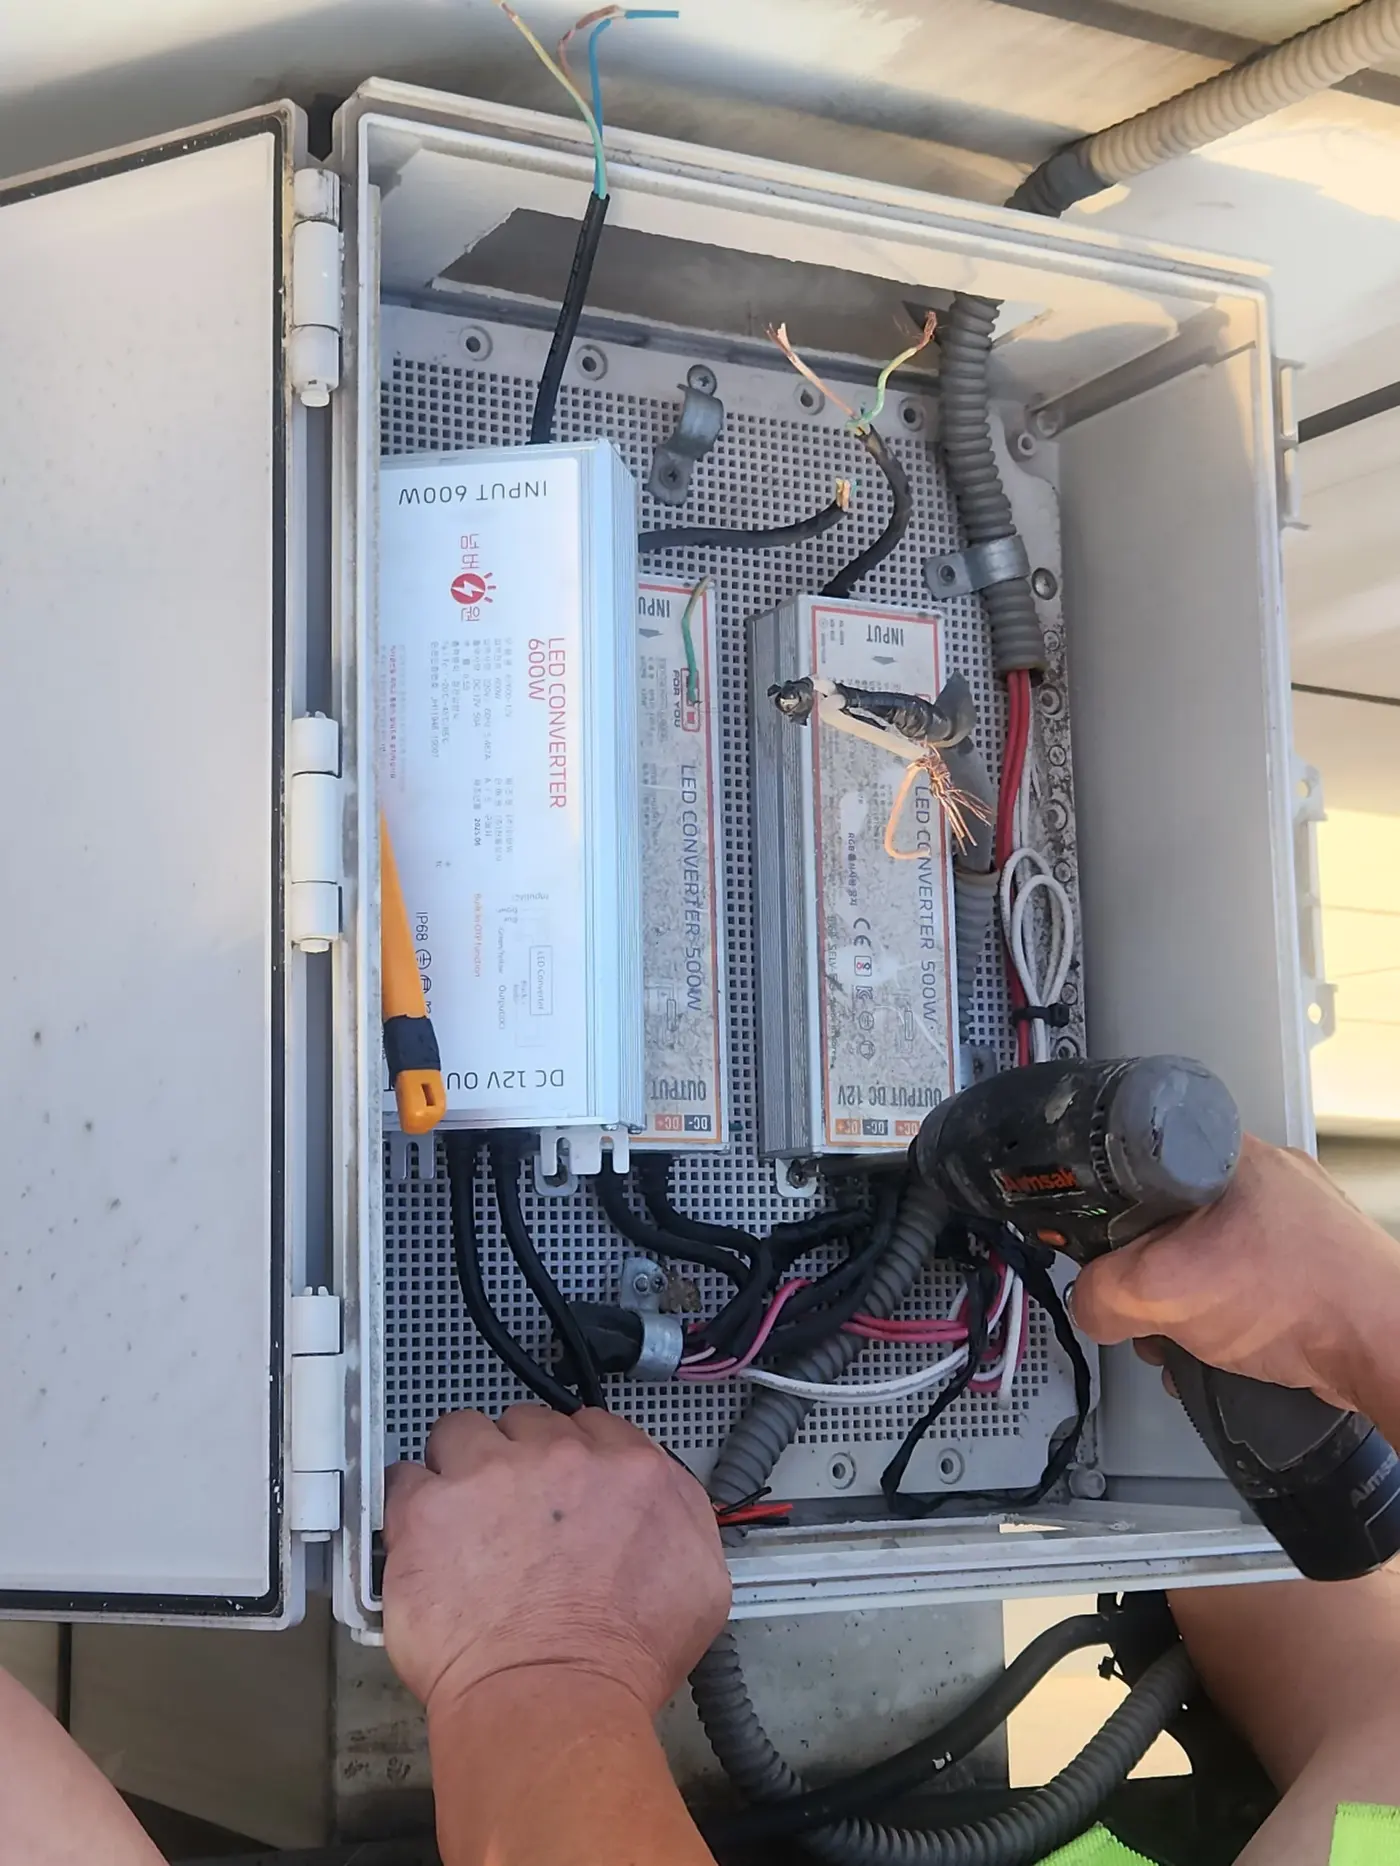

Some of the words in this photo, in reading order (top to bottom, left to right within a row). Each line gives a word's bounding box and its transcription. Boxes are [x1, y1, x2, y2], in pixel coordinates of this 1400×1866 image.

[399, 485, 467, 505] 600W
[476, 480, 547, 501] INPUT
[638, 596, 670, 618] INPU
[866, 624, 904, 647] INPUT
[528, 638, 545, 701] 600W
[548, 637, 566, 676] LED
[673, 701, 681, 728] YOU
[549, 683, 567, 809] CONVERTER
[681, 765, 698, 803] LED
[915, 786, 930, 823] LED
[682, 810, 701, 935] CONVERTER
[916, 830, 935, 950] CONVERTER
[416, 912, 428, 941] IP68
[686, 947, 702, 1011] 500W
[922, 961, 937, 1023] 500W
[487, 1070, 526, 1090] 12V
[535, 1068, 564, 1088] DC
[650, 1078, 706, 1101] OUTPUT
[838, 1085, 862, 1106] 12V
[868, 1086, 886, 1106] DC
[890, 1086, 942, 1108] OUTPUT
